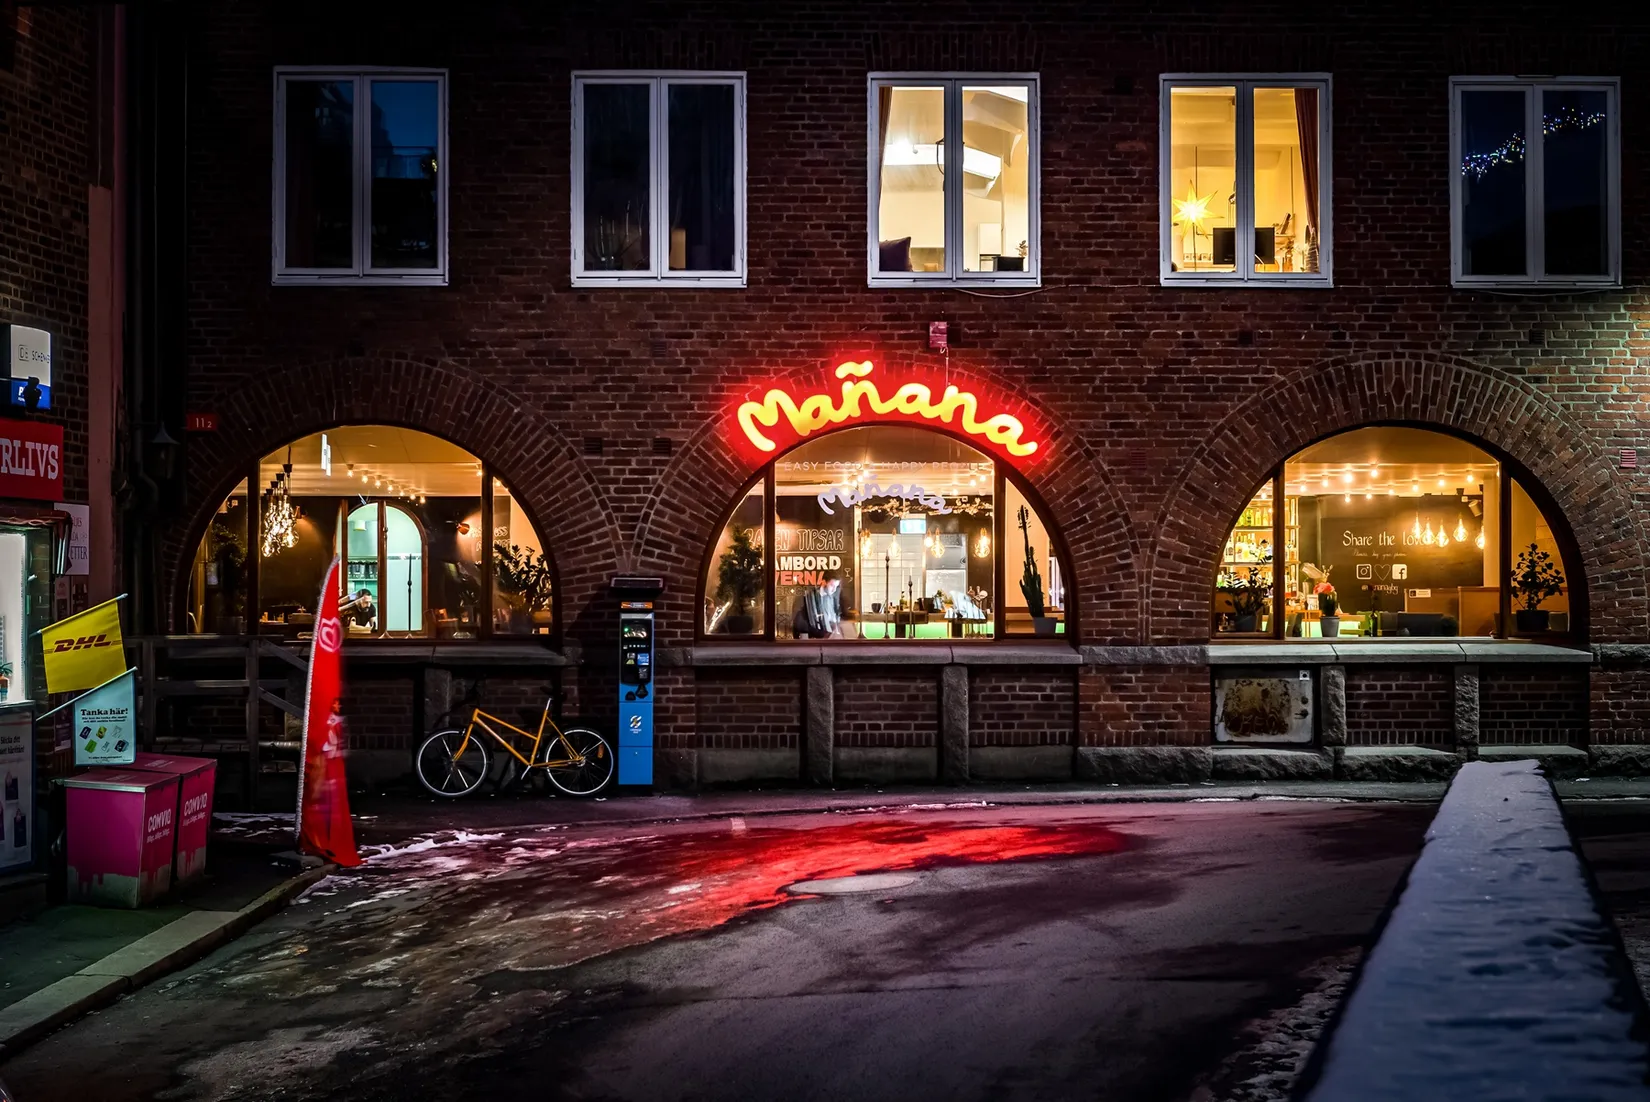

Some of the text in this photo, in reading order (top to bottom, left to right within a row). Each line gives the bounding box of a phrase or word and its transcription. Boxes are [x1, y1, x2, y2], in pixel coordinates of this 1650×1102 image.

[737, 360, 1038, 457] Mañana
[784, 461, 819, 471] EASY
[824, 461, 863, 471] FOOD
[882, 461, 927, 471] HAPPY
[817, 474, 953, 515] Mañana
[797, 528, 844, 551] TIPSAR
[1342, 530, 1373, 546] Share
[1378, 531, 1395, 546] the
[54, 634, 111, 653] DHL
[184, 792, 208, 817] COMVIQ
[148, 808, 171, 833] COMVIQ
